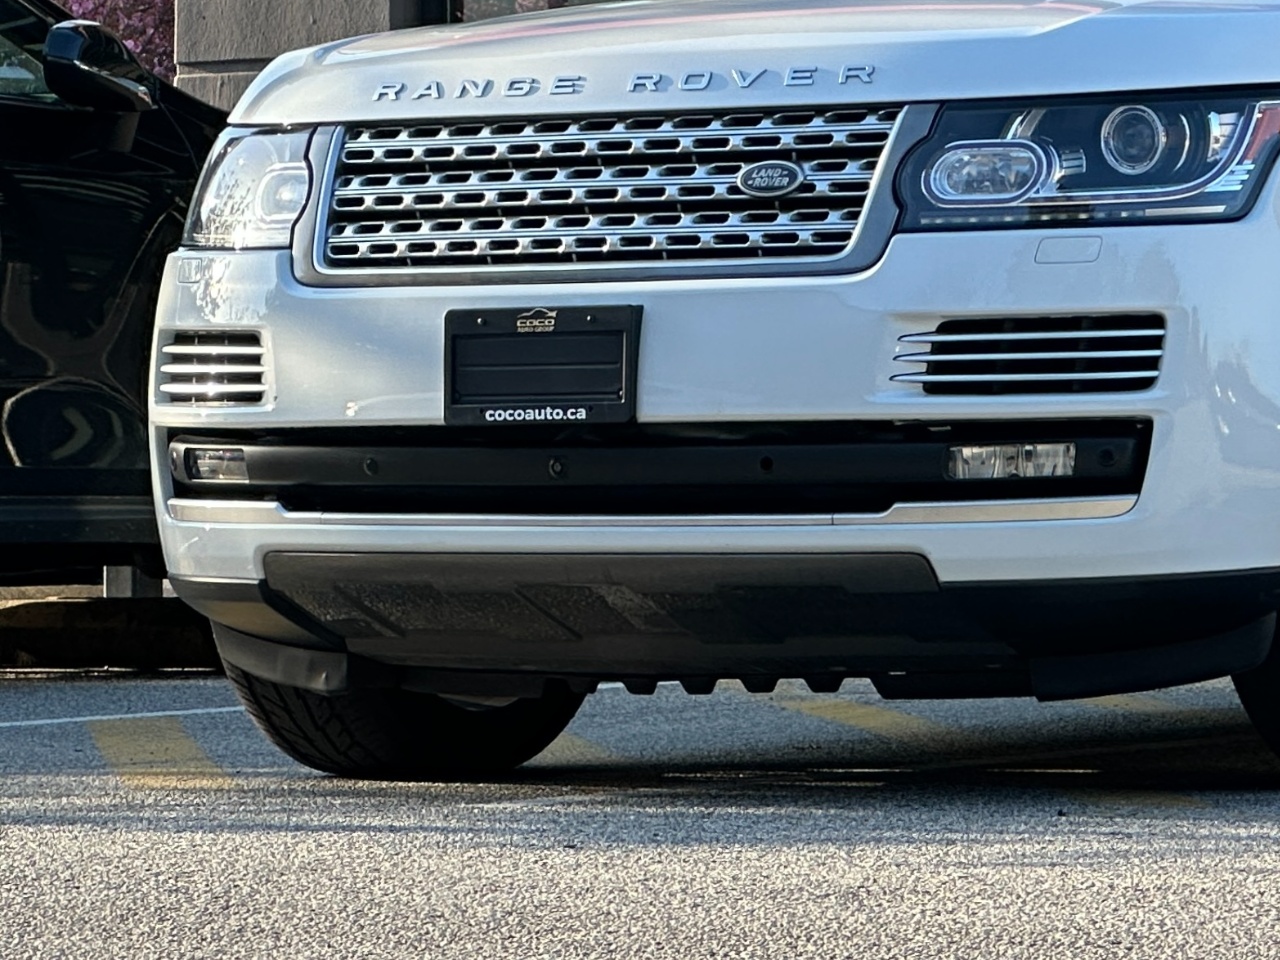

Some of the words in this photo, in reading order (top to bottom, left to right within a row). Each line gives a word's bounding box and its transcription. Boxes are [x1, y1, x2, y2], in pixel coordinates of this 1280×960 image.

[372, 78, 586, 101] RANGE
[627, 64, 875, 93] ROVER
[517, 319, 555, 327] COCO
[485, 406, 587, 422] cocoauto.ca
